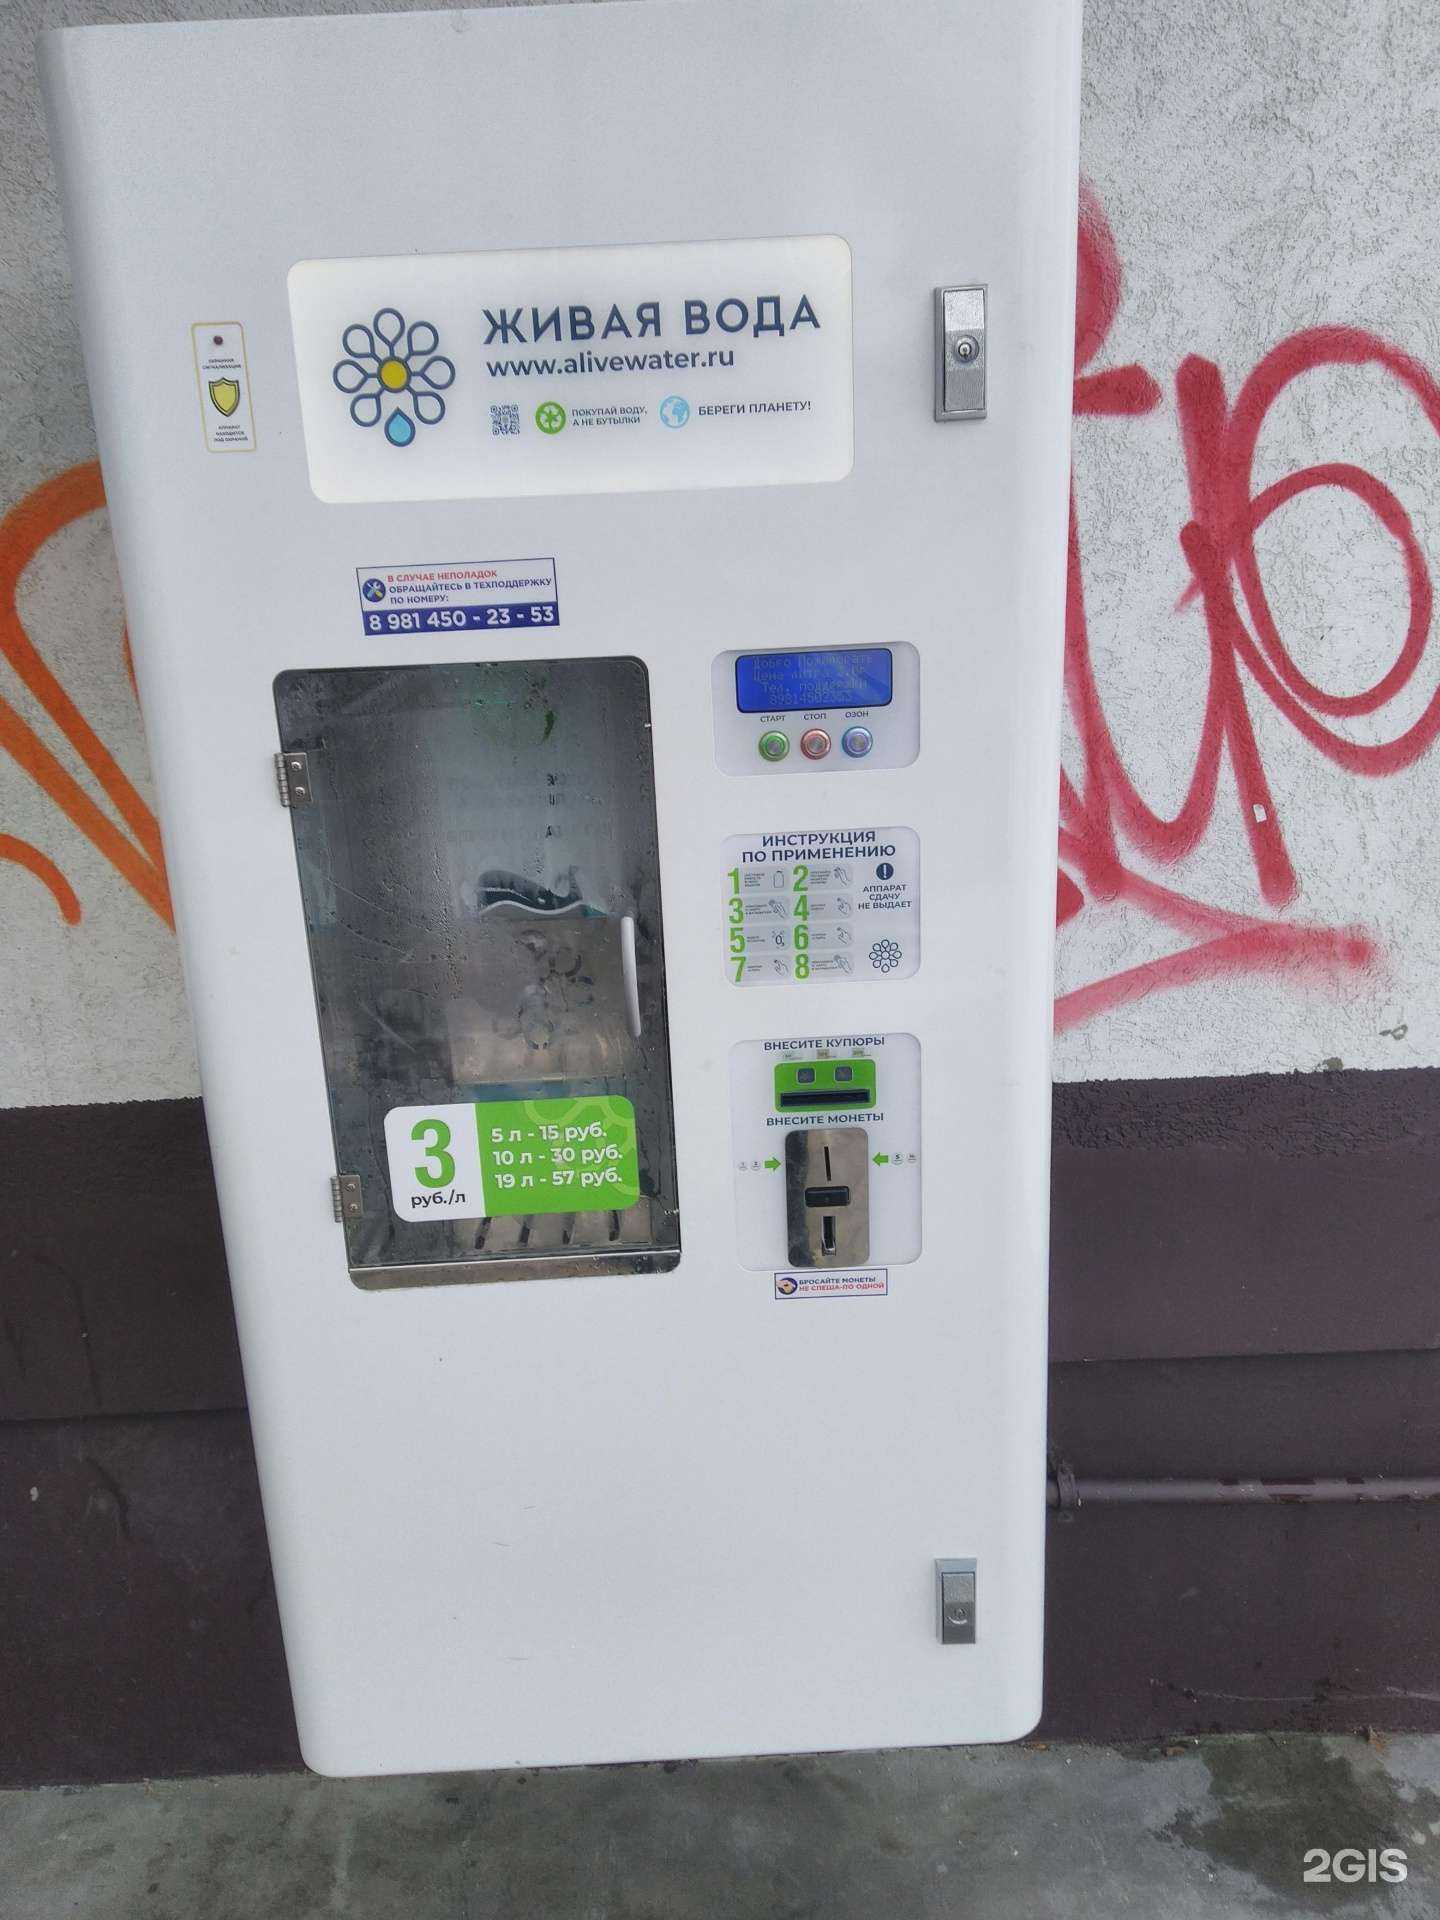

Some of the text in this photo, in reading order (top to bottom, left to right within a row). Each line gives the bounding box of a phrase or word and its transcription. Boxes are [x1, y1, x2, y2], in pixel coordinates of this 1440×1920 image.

[482, 294, 821, 344] ЖИВАЯ ВОДА
[486, 350, 735, 378] www.alivewater.ru
[571, 406, 618, 417] ПОКУПАЙ
[698, 401, 812, 417] БЕРЕГИ ПЛАНЕТУ!
[572, 416, 641, 427] А НЕ БУТЫЛКИ
[387, 570, 498, 583] В СЛУЧАЕ НЕПОЛАДОК
[389, 578, 552, 594] ОБРАЩАЙТЕСЬ В ТЕХПОДДЕРЖКУ
[390, 595, 449, 605] ПО НОМЕРУ:
[369, 615, 382, 631] 8
[387, 613, 421, 630] 981
[427, 611, 466, 628] 450
[486, 608, 511, 625] 23
[530, 606, 554, 623] 53
[760, 714, 786, 723] СТАРТ
[803, 712, 827, 721] СТОП
[845, 710, 869, 719] ОЗОН
[762, 831, 876, 848] ИНСТРУКЦИЯ
[742, 845, 896, 863] ПО ПРИМЕНЕНИЮ
[728, 867, 740, 895] 1
[793, 865, 809, 892] 2
[862, 884, 907, 893] АППАРАТ
[869, 893, 901, 901] СДАЧУ
[729, 897, 744, 924] 3
[793, 895, 809, 921] 4
[873, 901, 913, 910] ВЫДАЕТ
[730, 927, 746, 953] 5
[794, 924, 809, 950] 6
[730, 956, 747, 983] 7
[795, 954, 810, 979] 8
[764, 1036, 885, 1051] ВНЕСИТЕ КУПЮРЫ
[766, 1113, 884, 1126] ВНЕСИТЕ МОНЕТЫ
[491, 1128, 502, 1143] 5
[508, 1129, 521, 1142] л
[539, 1125, 559, 1141] 15
[565, 1121, 608, 1143] руб.
[411, 1118, 456, 1189] 3
[492, 1150, 514, 1166] 10
[519, 1151, 533, 1164] л
[551, 1148, 575, 1163] 30
[581, 1144, 623, 1164] руб.
[494, 1173, 515, 1189] 19
[520, 1174, 533, 1187] л
[551, 1170, 575, 1186] 57
[580, 1167, 623, 1187] руб.
[410, 1190, 466, 1209] руб./л
[856, 1282, 885, 1290] ОДНОЙ
